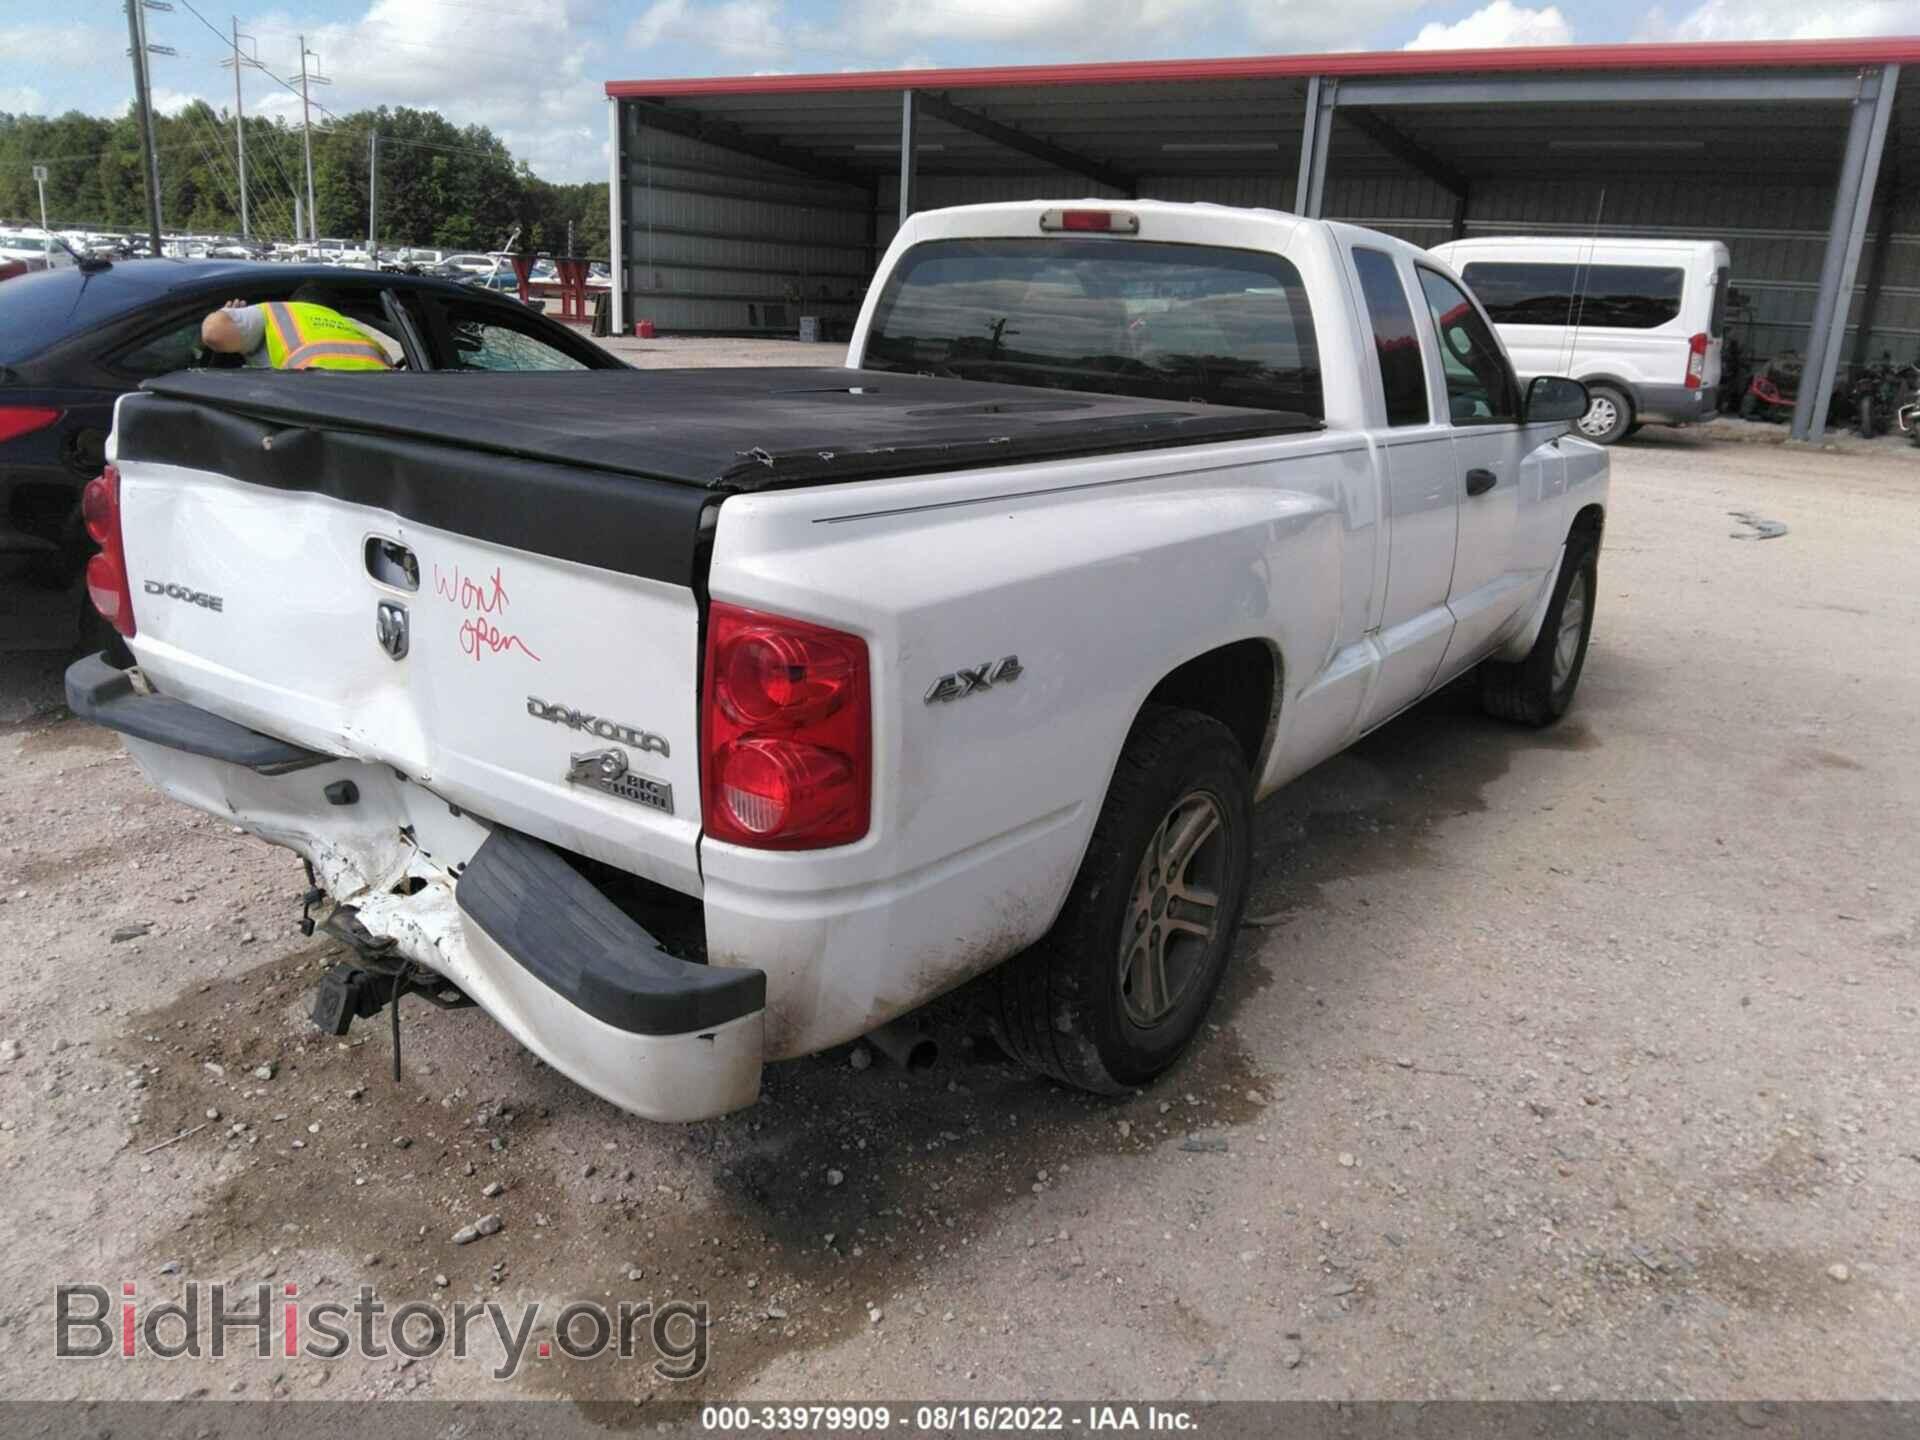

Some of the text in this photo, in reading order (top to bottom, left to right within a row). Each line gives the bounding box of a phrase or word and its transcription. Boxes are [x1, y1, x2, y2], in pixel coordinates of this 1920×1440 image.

[143, 579, 223, 613] DODGE
[434, 563, 510, 616] Wont
[526, 696, 671, 759] DAKOTA
[612, 782, 667, 809] HORN
[626, 774, 659, 794] BIG
